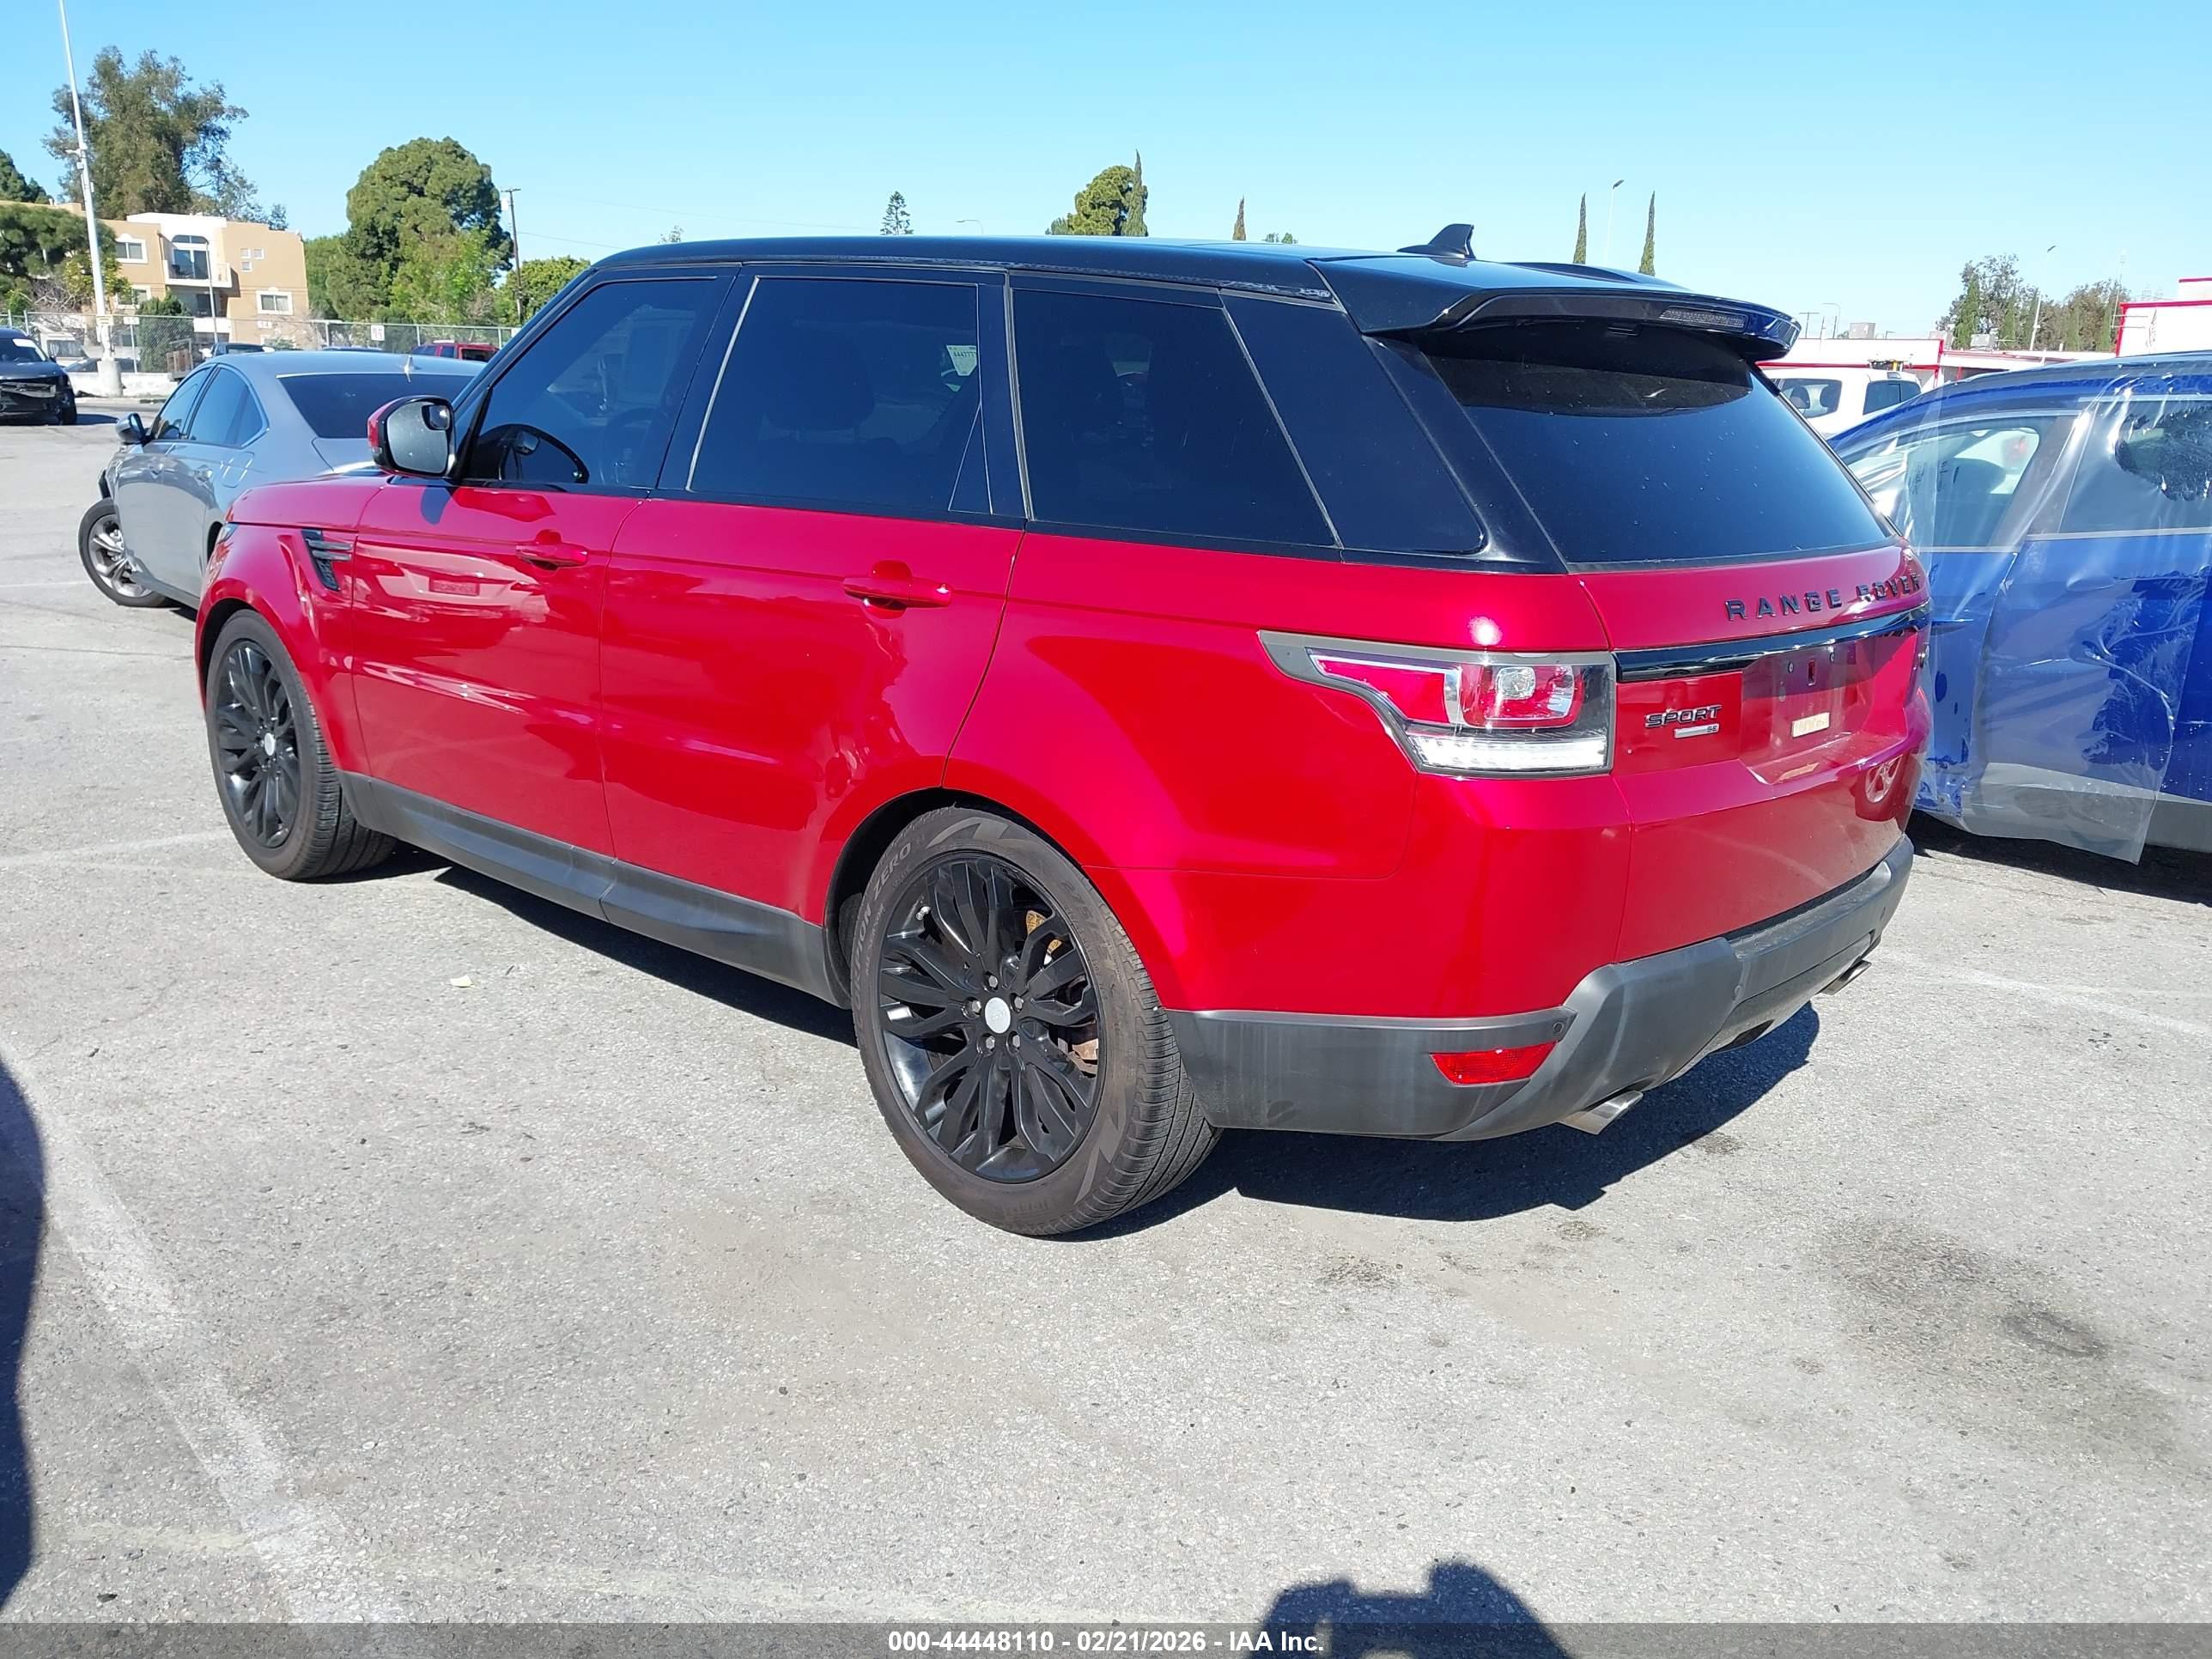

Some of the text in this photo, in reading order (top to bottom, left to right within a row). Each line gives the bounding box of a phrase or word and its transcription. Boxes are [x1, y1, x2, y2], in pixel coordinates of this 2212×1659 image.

[1725, 572, 1921, 621] RANGE ROVER
[1644, 704, 1722, 728] SPORT
[874, 842, 911, 901] ZERO
